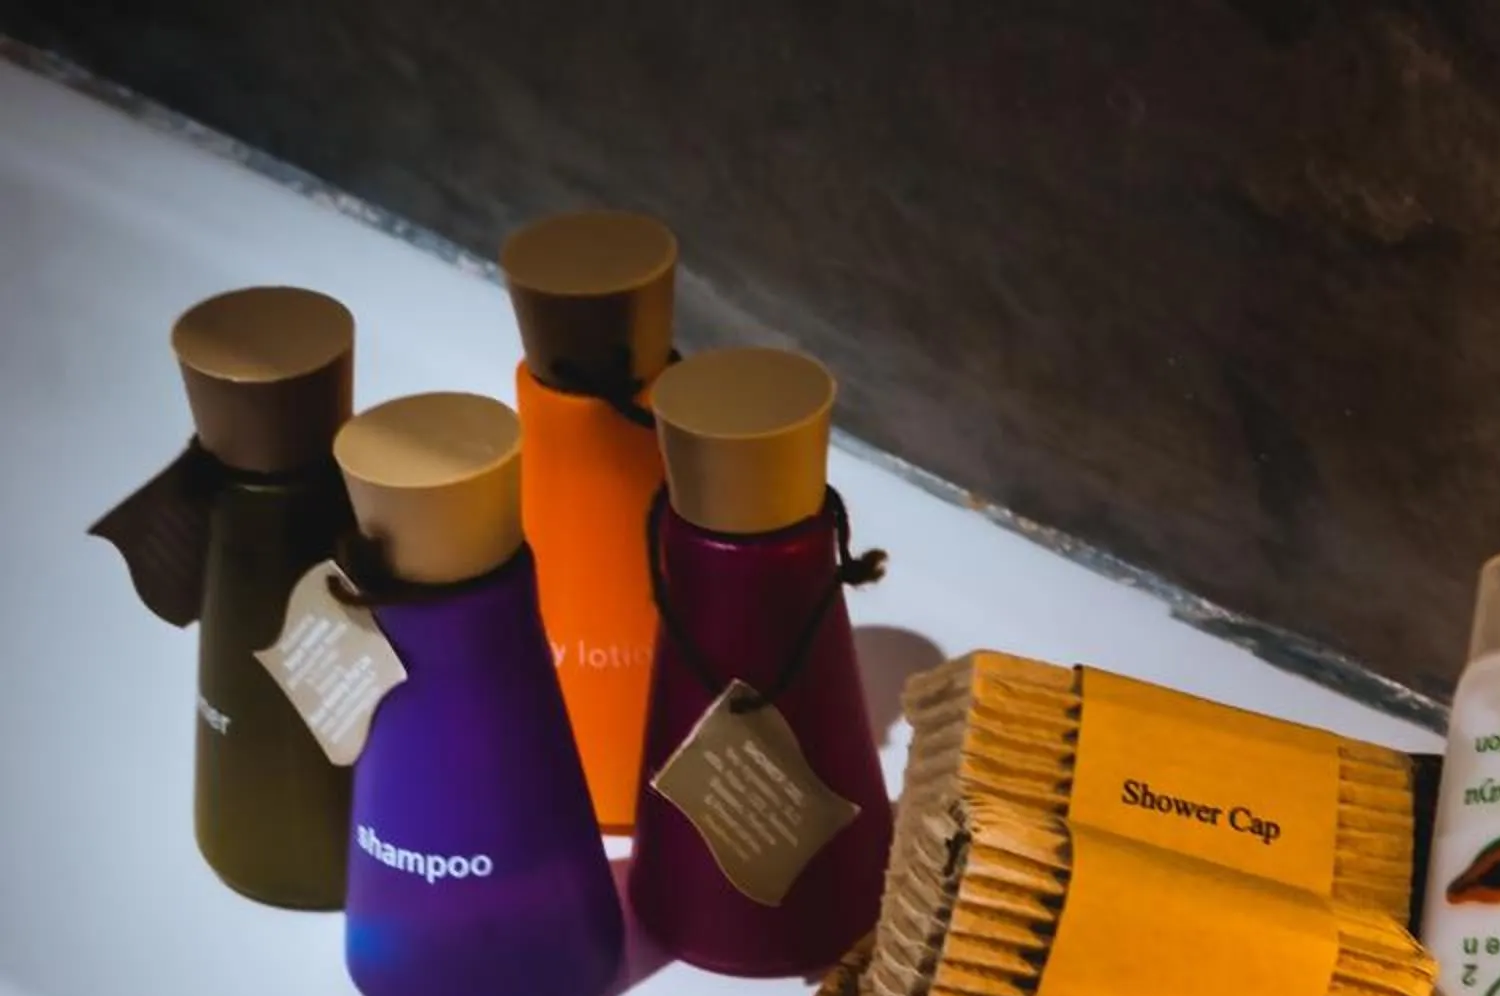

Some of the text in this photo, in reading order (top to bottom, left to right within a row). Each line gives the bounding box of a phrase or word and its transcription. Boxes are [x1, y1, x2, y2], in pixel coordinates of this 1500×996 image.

[1121, 778, 1282, 845] Shower Cap
[356, 824, 494, 885] shampoo
